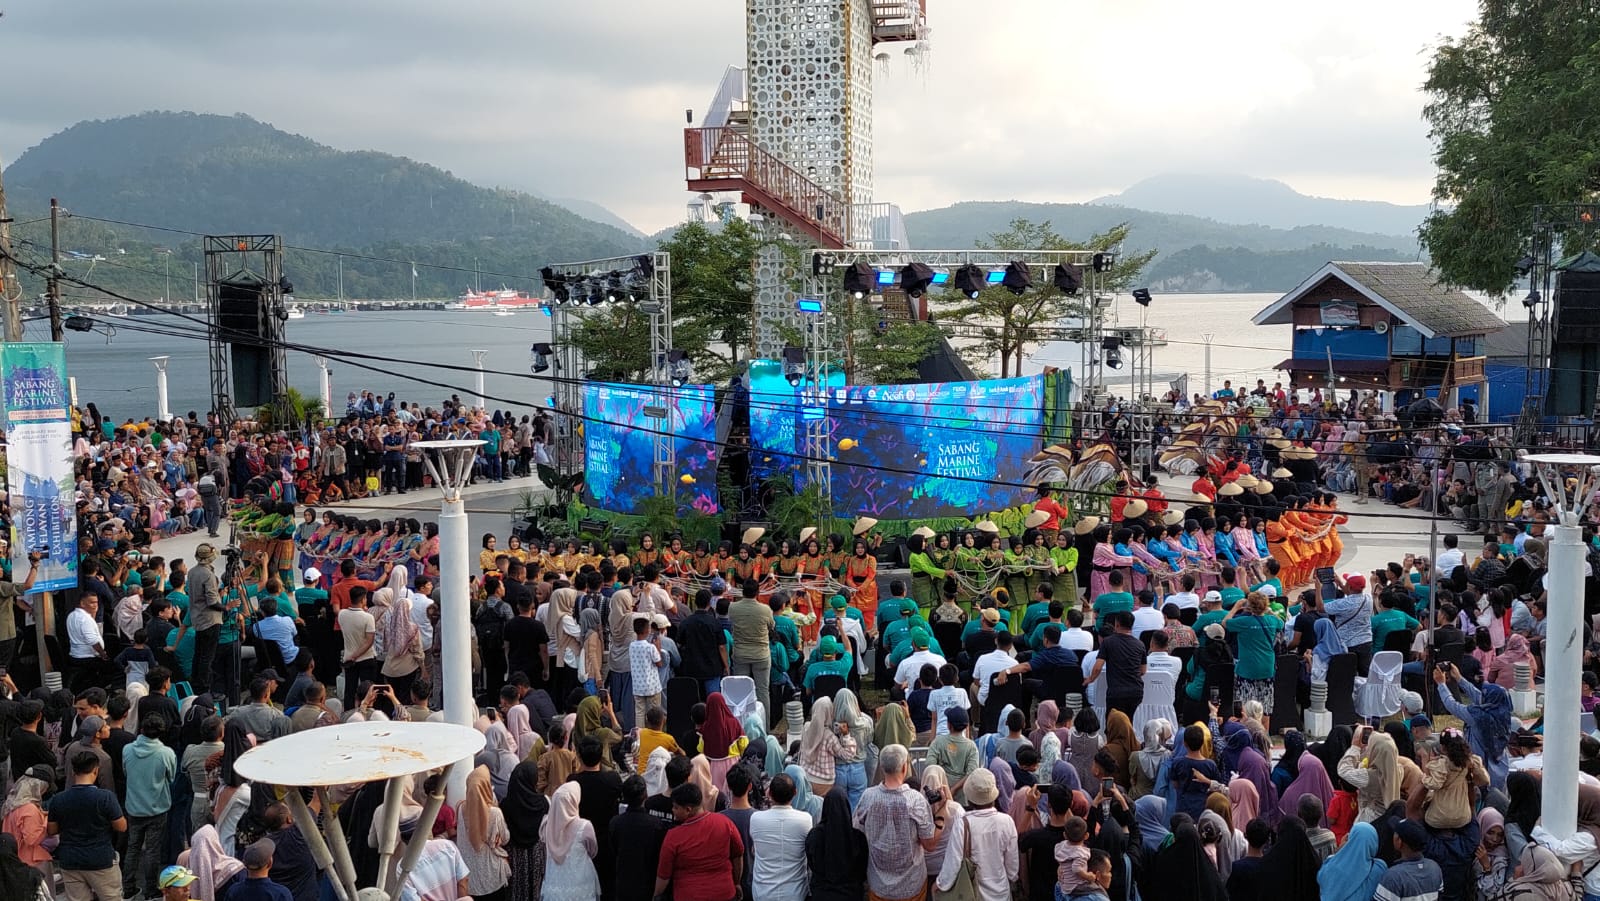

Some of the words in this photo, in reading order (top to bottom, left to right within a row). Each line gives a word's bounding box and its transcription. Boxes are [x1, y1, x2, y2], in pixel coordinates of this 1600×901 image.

[14, 380, 55, 390] SABANG
[14, 388, 57, 398] MARINE
[13, 397, 59, 407] FESTIVAL
[938, 440, 981, 456] SABANG
[938, 454, 981, 467] MARINE
[937, 466, 983, 477] FESTIVAL
[25, 499, 36, 552] AMPONG
[50, 495, 62, 555] EXHIBITION
